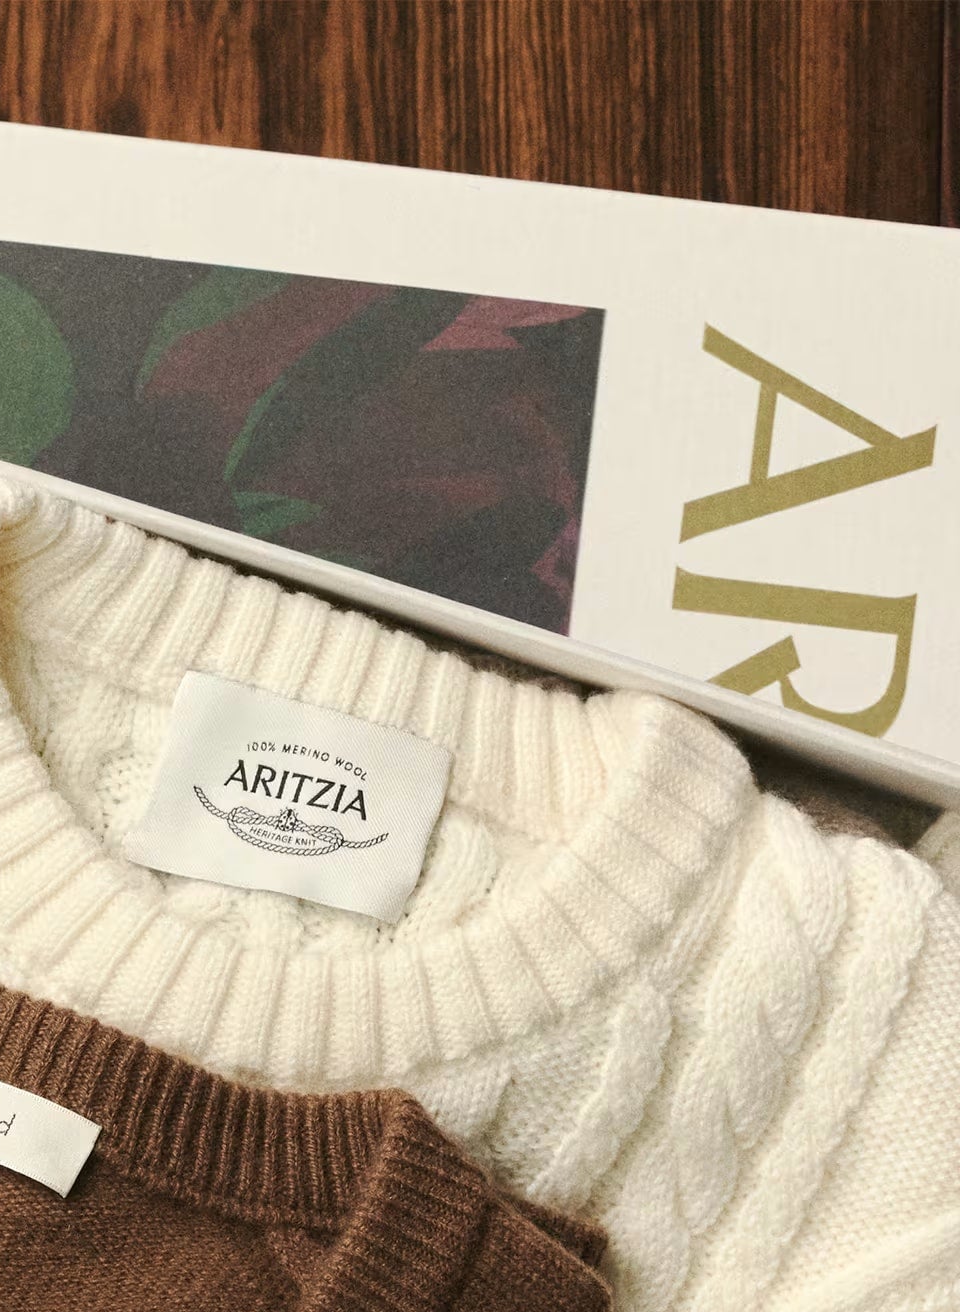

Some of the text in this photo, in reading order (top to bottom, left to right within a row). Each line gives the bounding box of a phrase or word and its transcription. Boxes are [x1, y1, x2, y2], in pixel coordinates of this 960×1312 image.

[672, 321, 938, 738] AR
[247, 741, 368, 781] 100% MERINO WOOL
[223, 759, 367, 821] ARITZIA
[249, 825, 317, 847] HERITAGE KNIT
